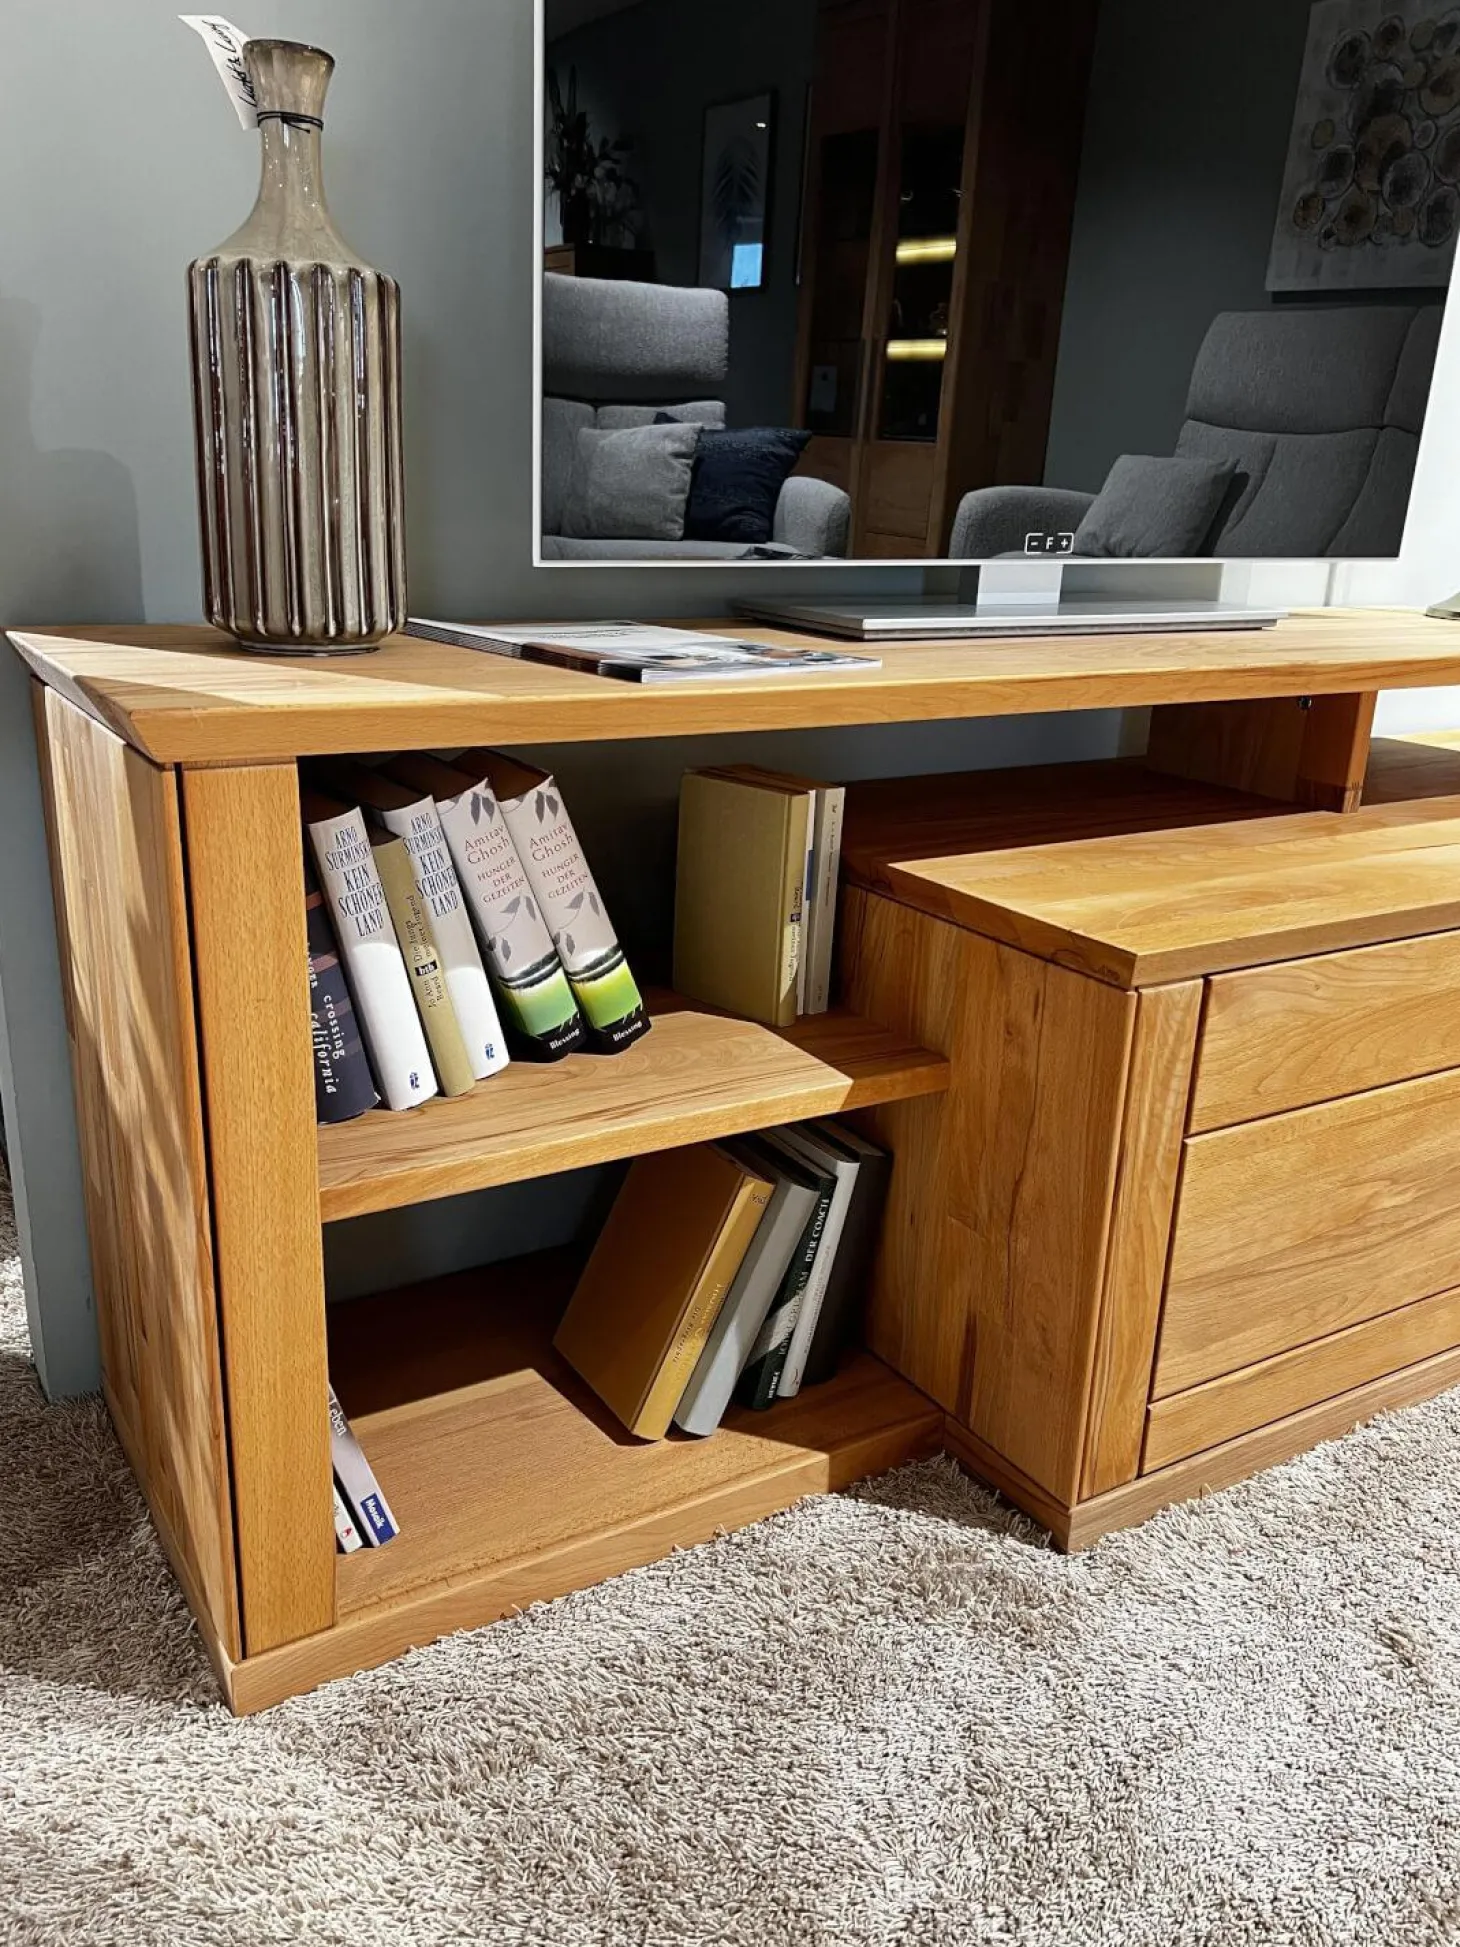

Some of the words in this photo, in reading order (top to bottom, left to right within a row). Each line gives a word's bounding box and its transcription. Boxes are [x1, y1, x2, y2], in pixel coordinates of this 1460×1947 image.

[1046, 537, 1054, 549] F
[403, 825, 443, 855] SURMINSK
[465, 825, 504, 852] Amitav
[467, 836, 509, 864] Ghosh
[530, 824, 567, 849] Amitav
[532, 834, 573, 862] Ghosh
[325, 841, 371, 871] SURMINSK
[420, 848, 445, 875] KEIN
[477, 856, 516, 881] HUNGER
[541, 853, 580, 878] HUNGER
[343, 863, 371, 892] KEIN
[483, 875, 525, 903] GEZEITEN
[493, 872, 512, 887] DER
[548, 871, 588, 899] GEZEITEN
[558, 869, 576, 883] DER
[432, 890, 458, 917] LAND
[355, 909, 384, 937] LAND
[324, 995, 345, 1060] crossing
[549, 1027, 580, 1050] Blessing
[612, 1020, 643, 1042] Blessing
[311, 1013, 339, 1094] california
[805, 1241, 818, 1262] DER
[812, 1199, 829, 1238] COACH
